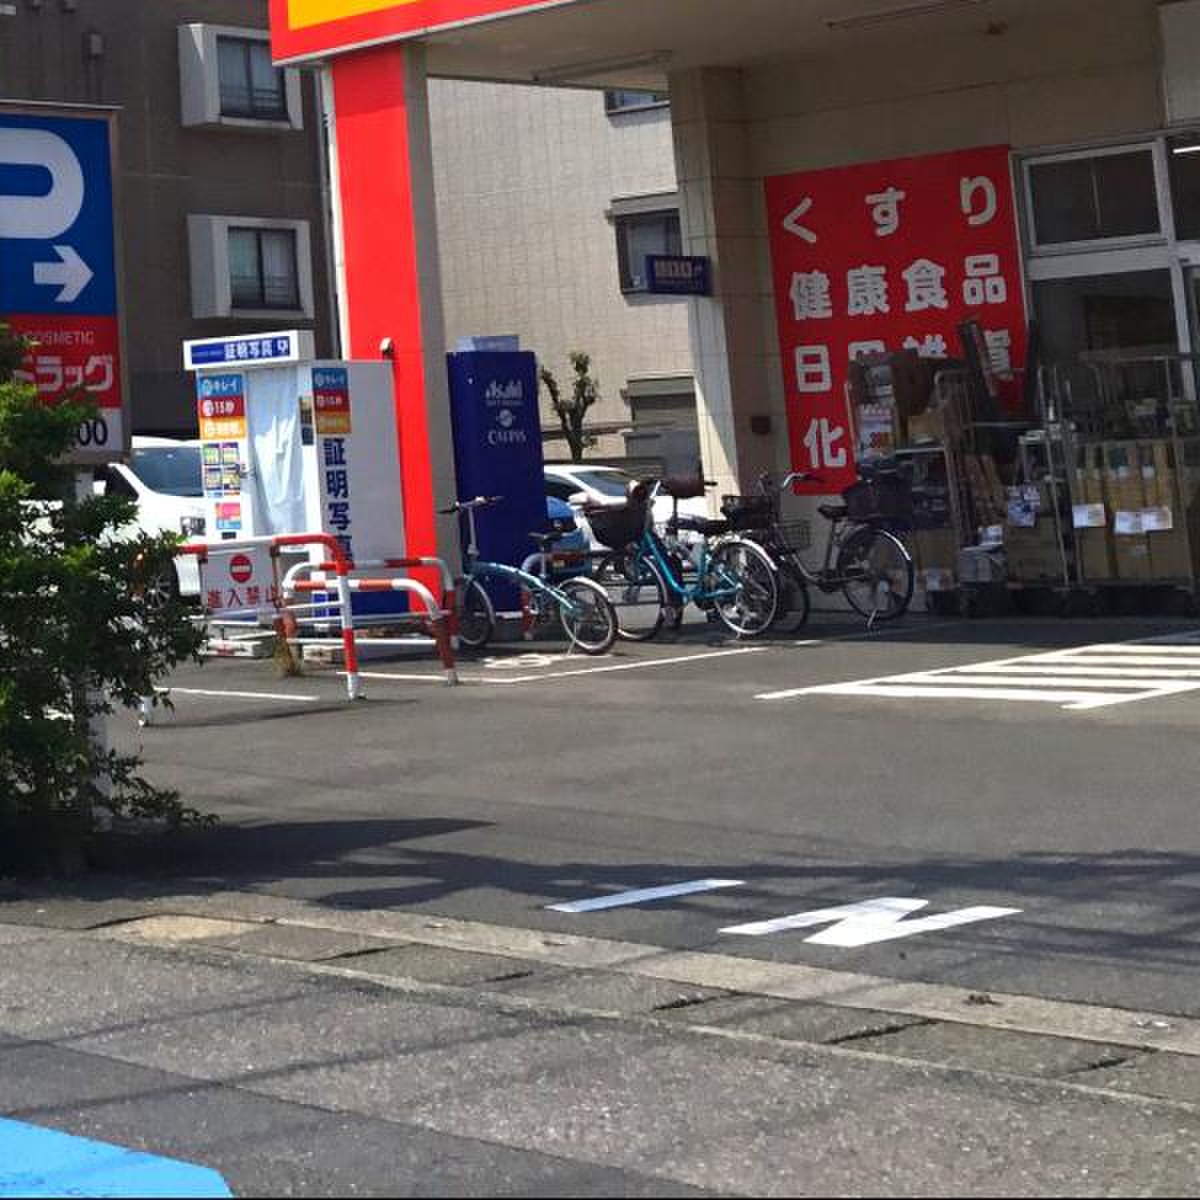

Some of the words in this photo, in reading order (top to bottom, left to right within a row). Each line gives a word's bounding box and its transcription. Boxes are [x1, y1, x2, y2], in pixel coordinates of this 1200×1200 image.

[783, 176, 998, 244] くすり
[789, 253, 1007, 321] 健康食品
